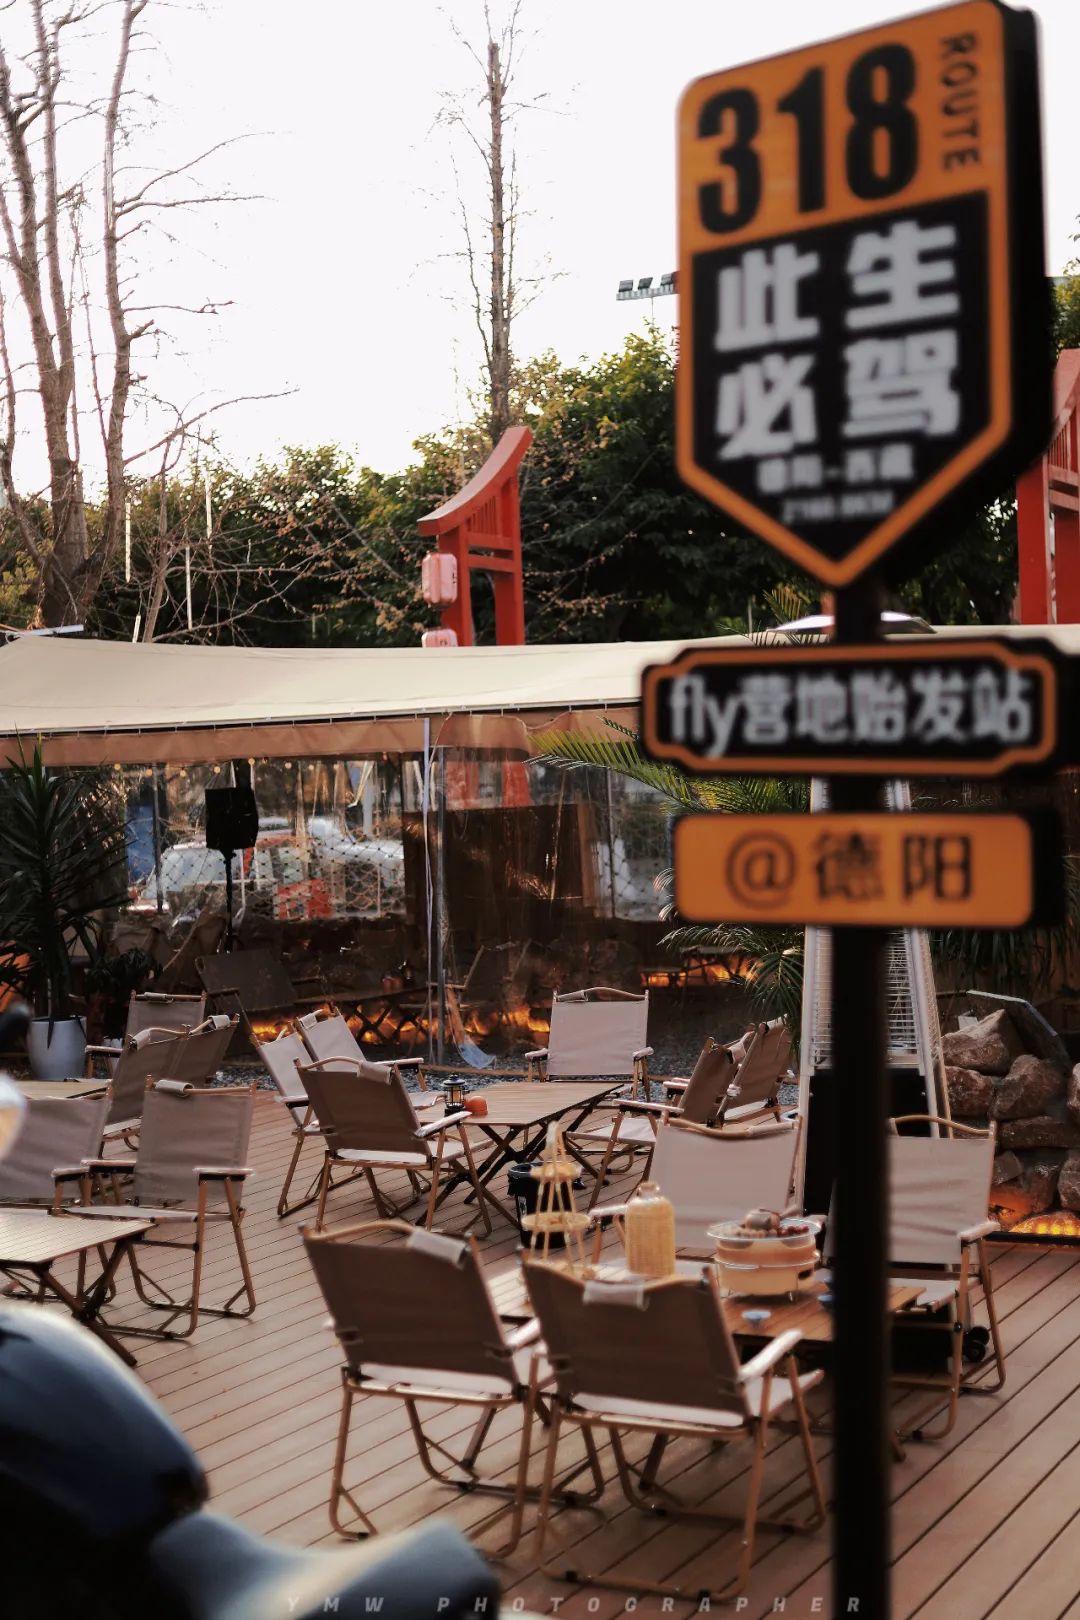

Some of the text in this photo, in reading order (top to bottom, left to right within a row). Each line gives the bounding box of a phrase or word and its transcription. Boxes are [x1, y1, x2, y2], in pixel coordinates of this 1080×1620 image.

[697, 43, 920, 234] 318
[940, 32, 980, 172] ROUTE
[715, 220, 960, 352] 此生
[715, 329, 960, 460] 必驾
